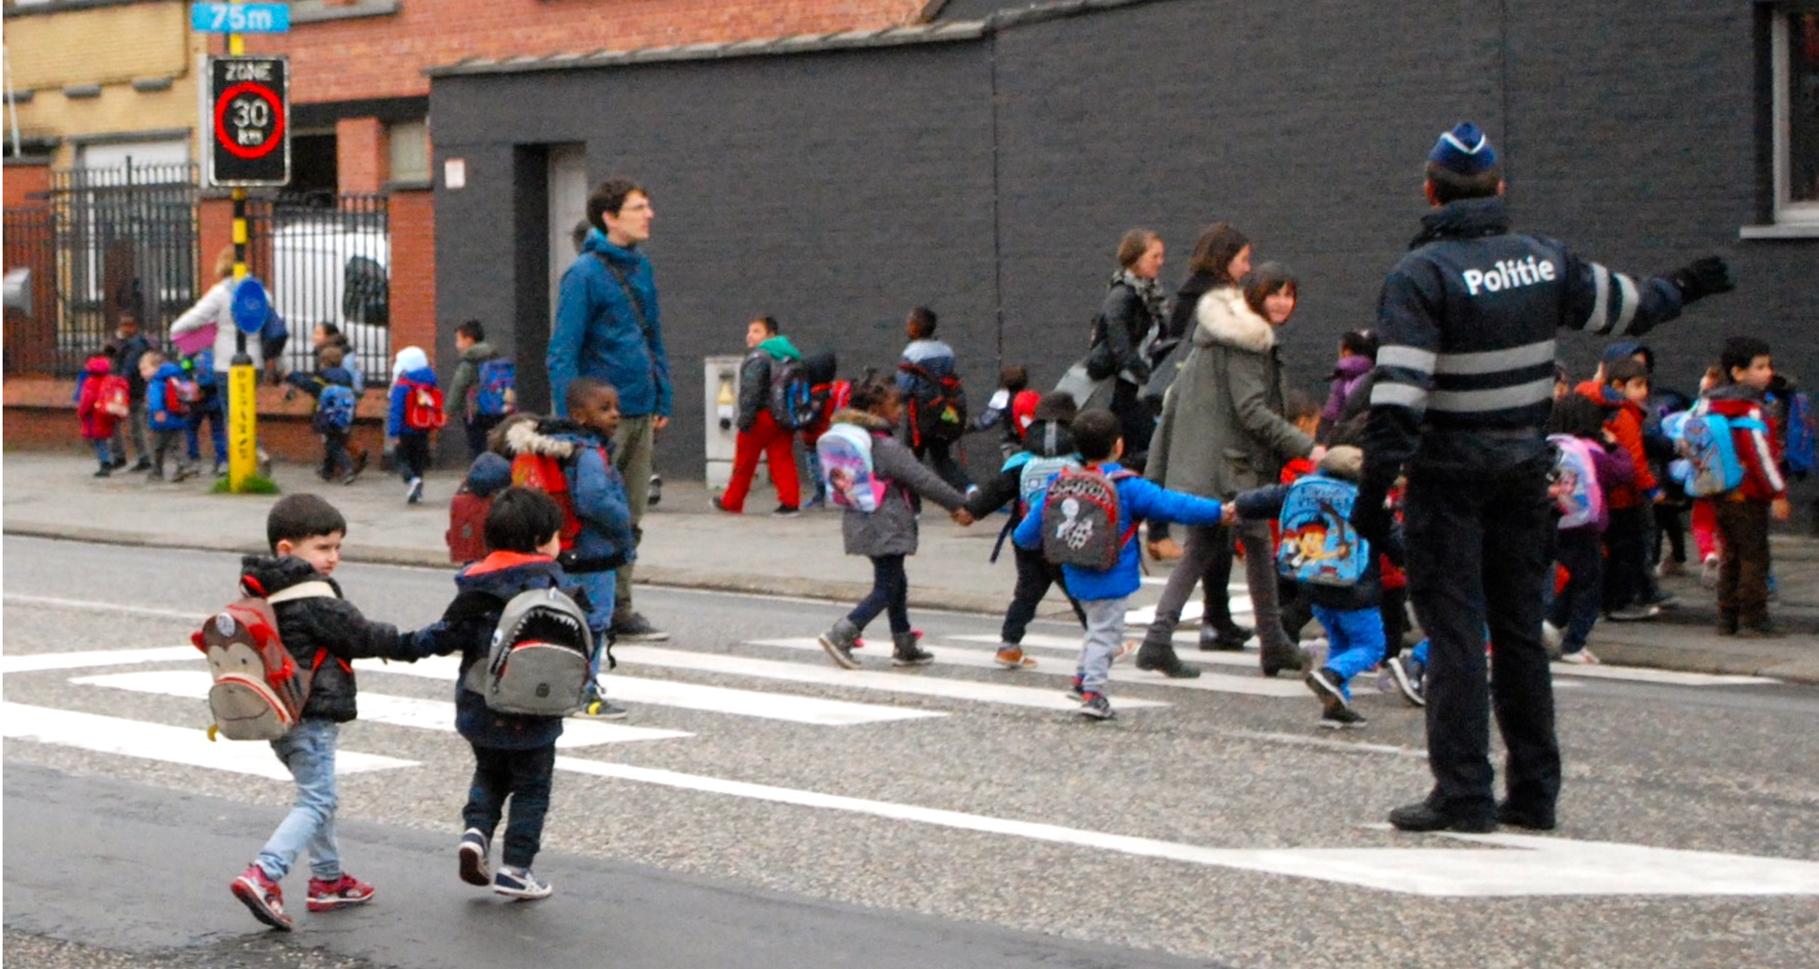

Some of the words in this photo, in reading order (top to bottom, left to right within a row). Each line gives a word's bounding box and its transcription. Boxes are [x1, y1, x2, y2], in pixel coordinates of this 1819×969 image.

[211, 5, 273, 30] 75m
[225, 62, 273, 81] ZONE
[233, 99, 269, 128] 30
[237, 128, 264, 145] km
[1462, 255, 1555, 295] Politie
